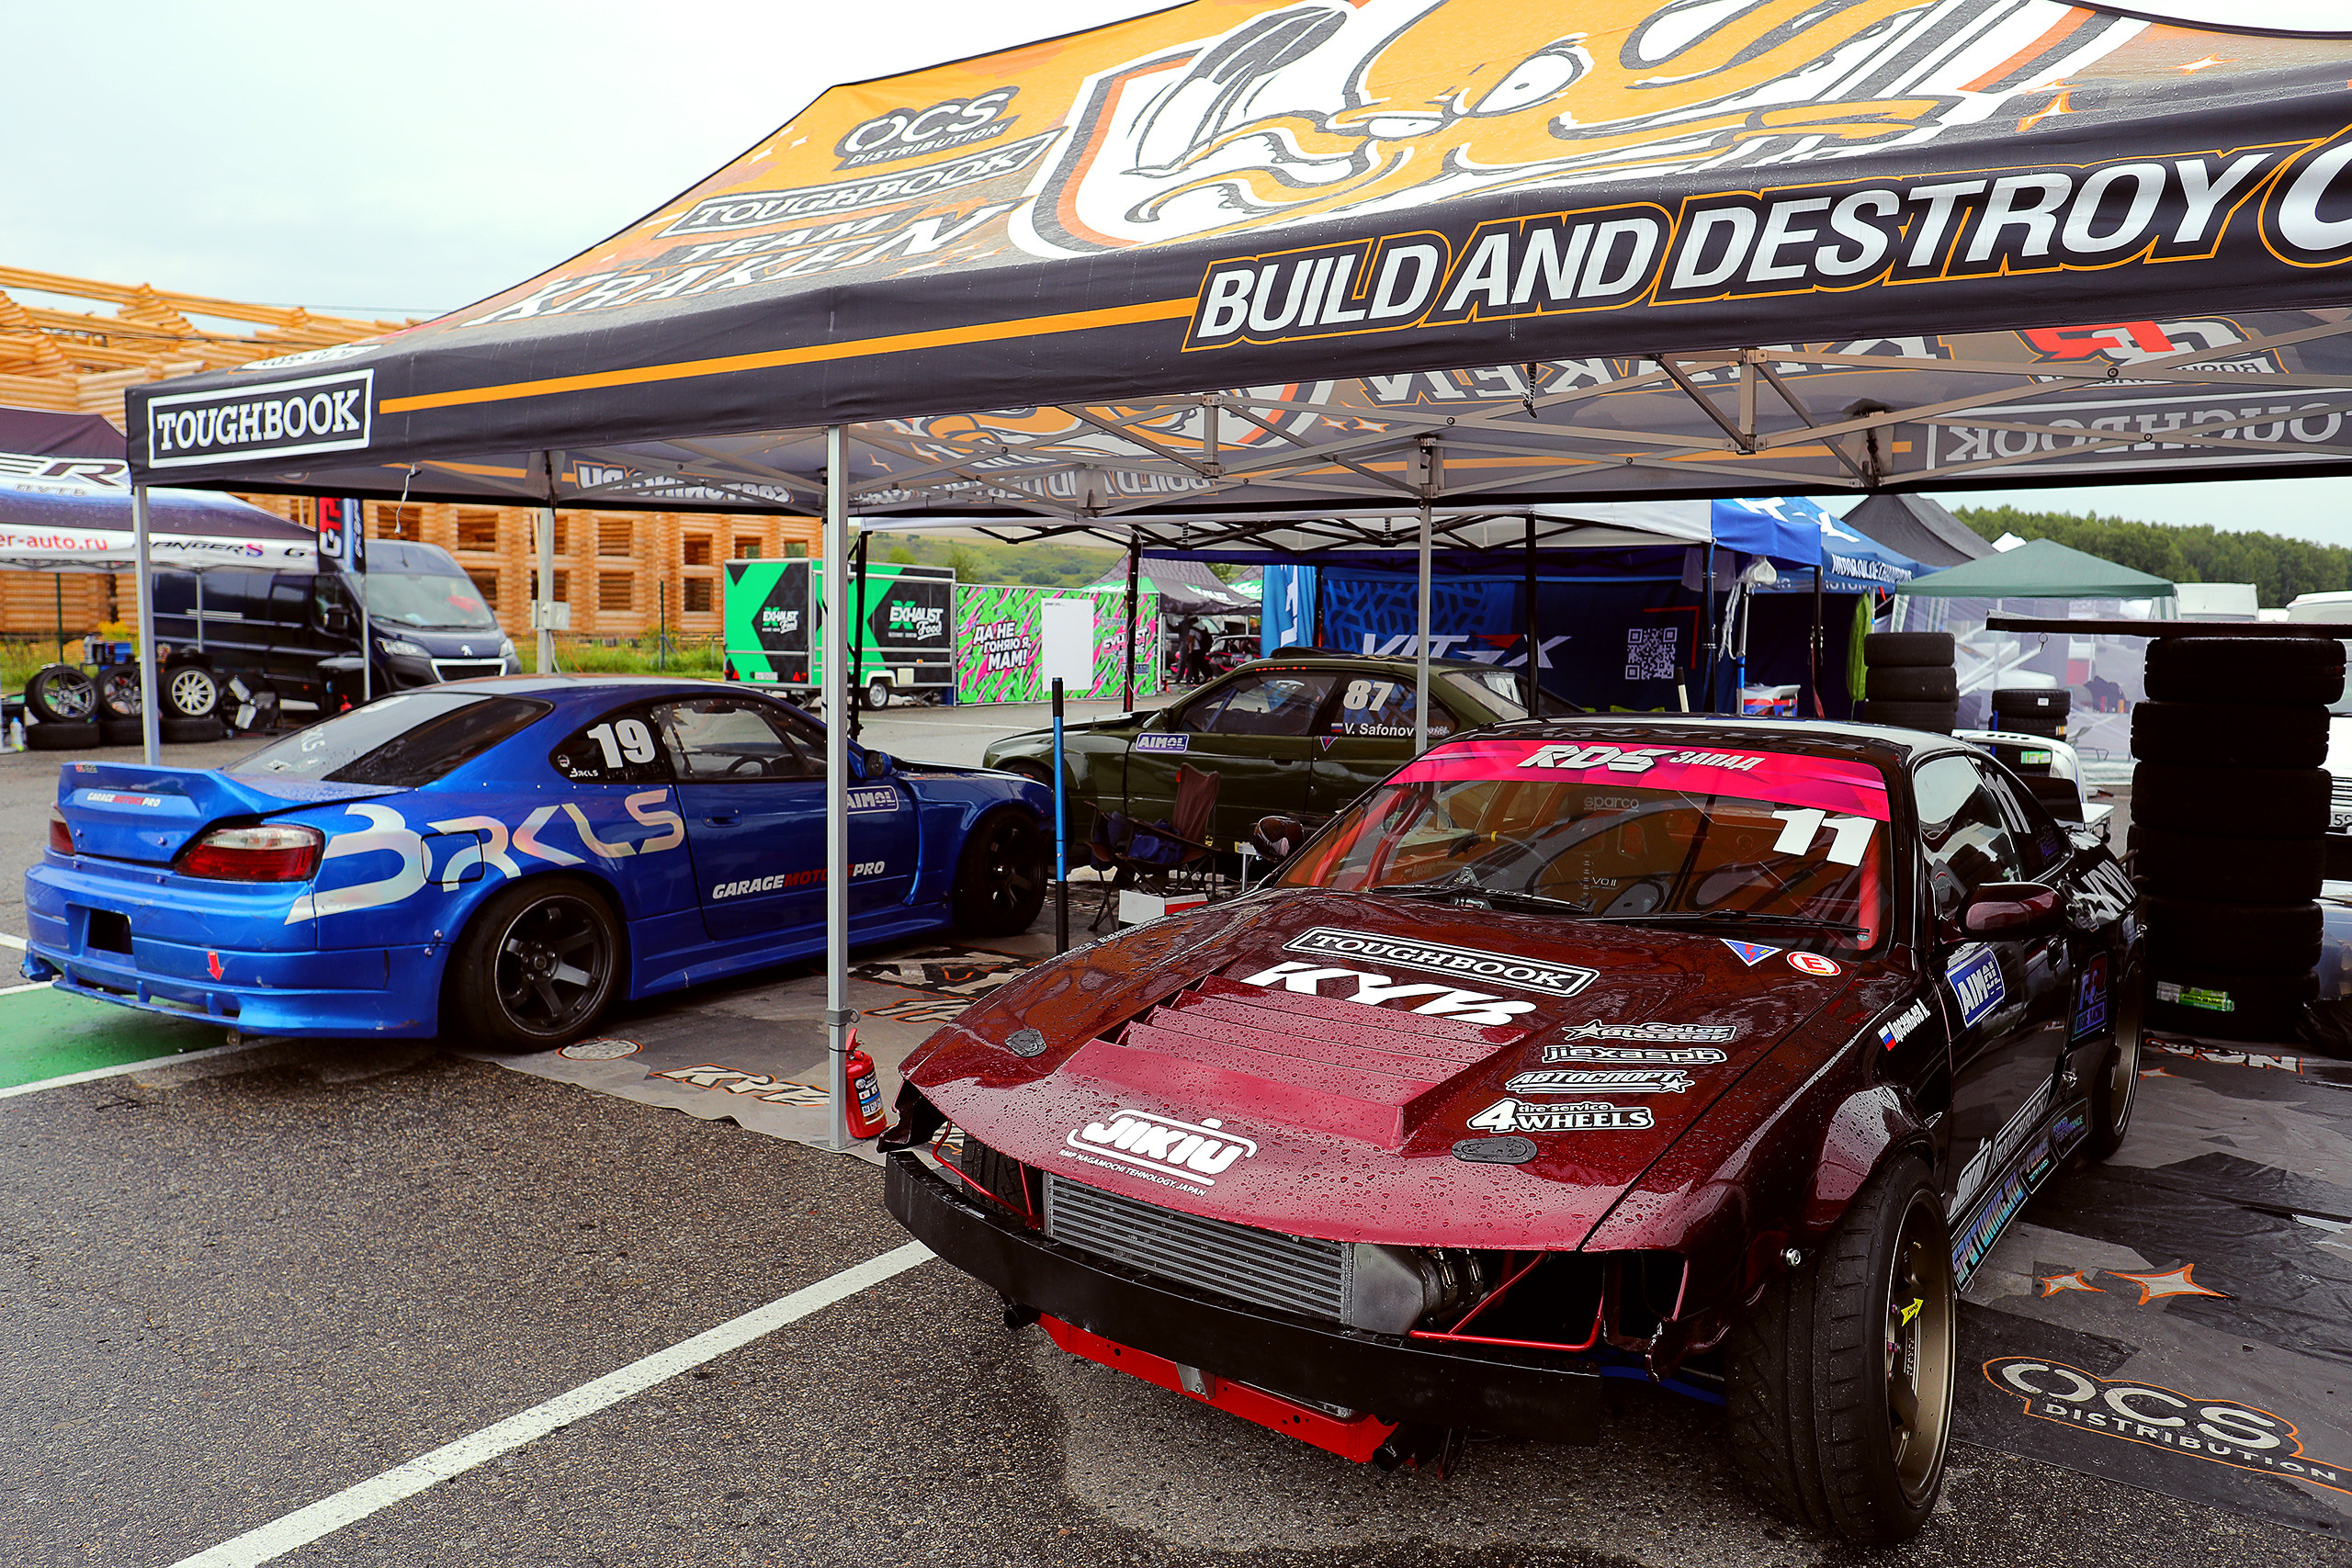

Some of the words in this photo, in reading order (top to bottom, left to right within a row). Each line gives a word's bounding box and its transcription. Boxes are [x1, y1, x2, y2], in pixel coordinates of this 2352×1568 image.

[844, 91, 1012, 156] OCS
[849, 121, 1007, 167] DISTRIBUTION
[699, 148, 1027, 227] TOUGHBOOK
[679, 212, 892, 264] TEAM
[1196, 243, 1439, 339] BUILD
[1443, 217, 1659, 312] AND
[1670, 152, 2274, 290] DESTROY
[460, 201, 1020, 327] KRAKEN
[157, 389, 361, 452] TOUGHBOOK
[134, 540, 264, 558] ANGERS
[889, 603, 944, 627] EXHAUST
[973, 624, 994, 645] ДА
[996, 621, 1016, 638] НЕ
[983, 637, 1021, 654] ГОНЯЮ
[988, 649, 1028, 671] МАМ!
[1342, 680, 1395, 712] 87
[587, 718, 655, 769] 19
[1138, 736, 1184, 750] AIMOL
[1344, 723, 1355, 736] V.
[1360, 722, 1415, 738] Safonov
[1516, 744, 1677, 773] RDS
[1668, 750, 1766, 772] ЗАПАД
[1583, 795, 1639, 811] sparco
[1984, 772, 2032, 834] 11
[1770, 807, 1877, 867] 11
[1312, 932, 1573, 988] TOUGHBOOK
[1801, 955, 1827, 971] E
[1240, 961, 1537, 1026] KYB
[1957, 960, 2003, 1017] AIMOL
[1601, 1028, 1728, 1041] Blaster
[1645, 1024, 1729, 1034] Color
[1469, 1100, 1518, 1131] 4
[1518, 1112, 1650, 1129] WHEELS
[1519, 1103, 1548, 1112] tire
[1550, 1103, 1610, 1112] service
[1080, 1110, 1244, 1176] JIKIU
[1057, 1148, 1078, 1160] RMP
[1076, 1153, 1126, 1175] NAGAMOCHI
[1176, 1182, 1207, 1198] JAPAN
[2001, 1362, 2280, 1450] OCS
[2044, 1403, 2337, 1482] DISTRIBUTION
